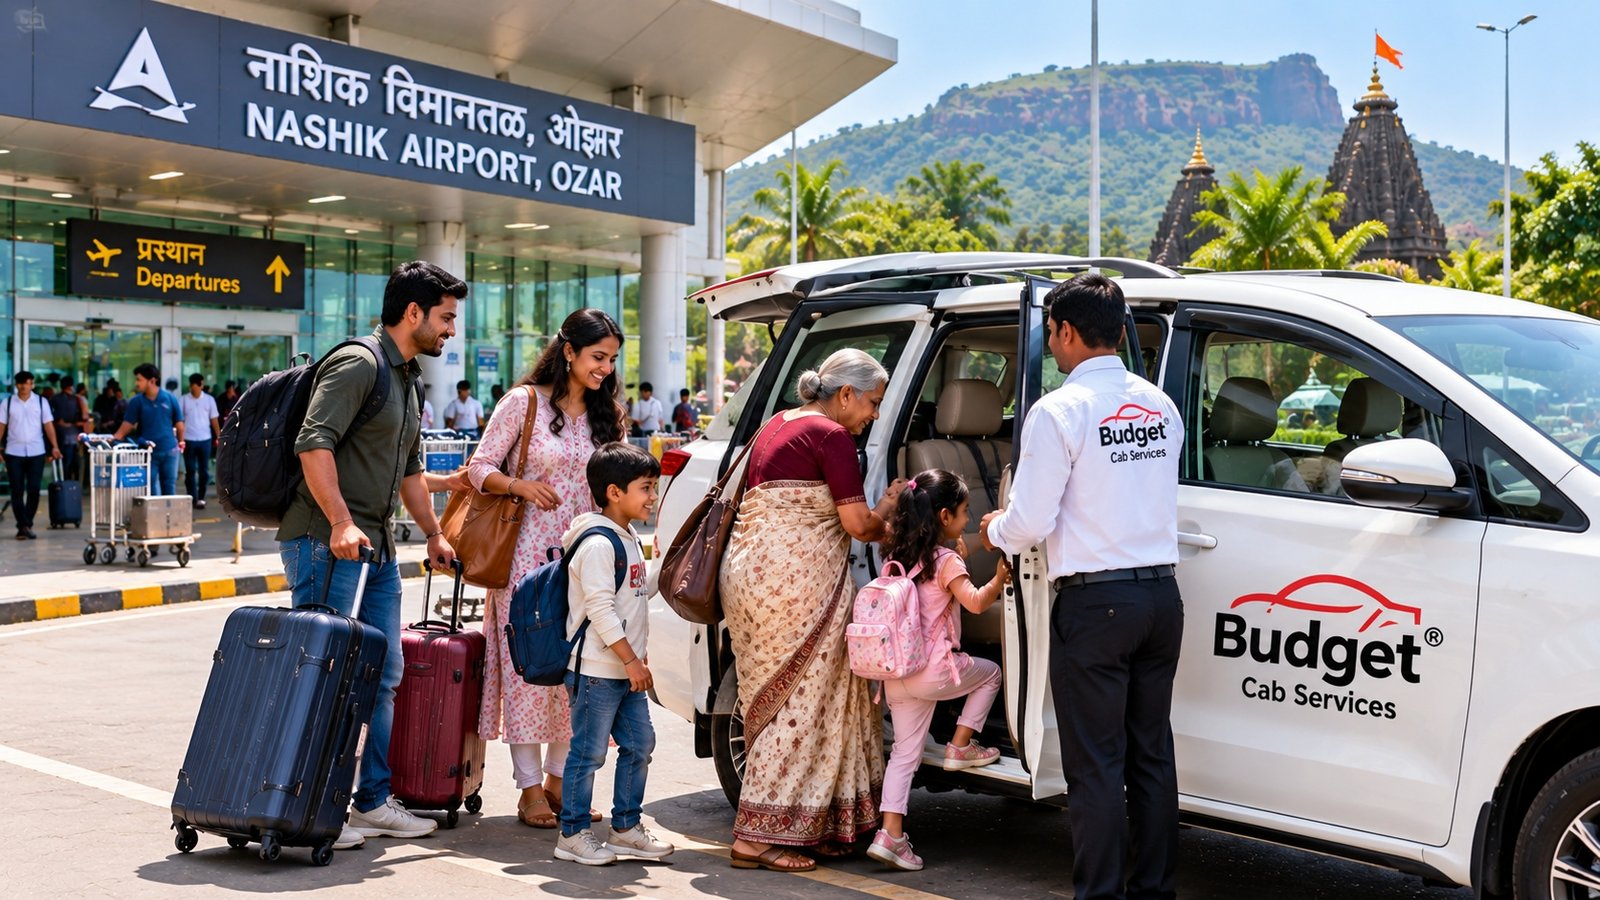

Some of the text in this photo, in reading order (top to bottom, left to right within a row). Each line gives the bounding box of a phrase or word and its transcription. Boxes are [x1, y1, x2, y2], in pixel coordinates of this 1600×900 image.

[246, 43, 623, 160] नाशिक विमानतळ, ओझर
[246, 102, 622, 201] NASHIK AIRPORT, OZAR
[136, 238, 206, 266] प्रस्थान
[136, 266, 240, 294] Departures
[1110, 448, 1167, 464] Cab Services
[1241, 676, 1397, 720] Cab Services
